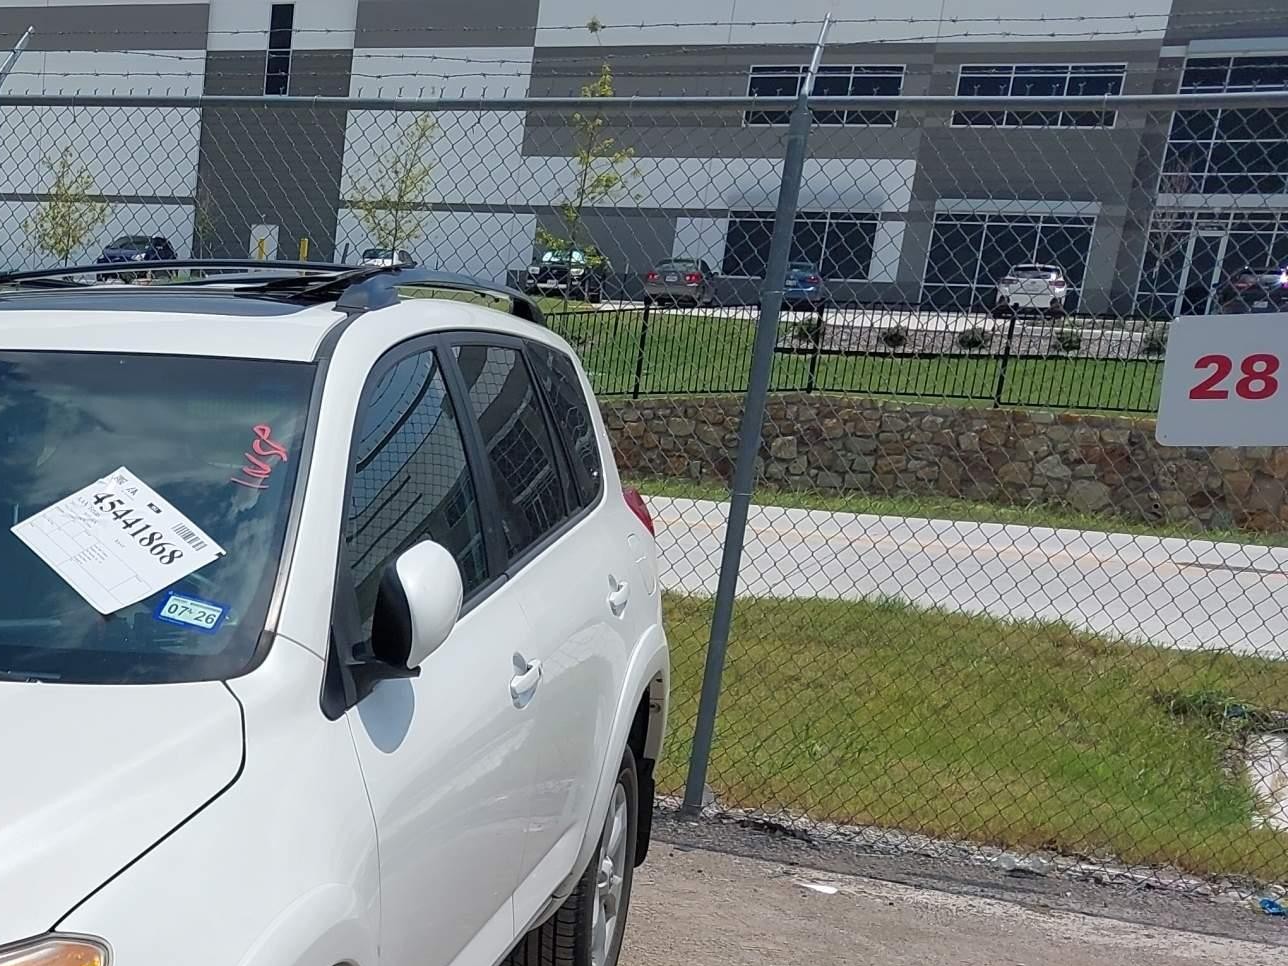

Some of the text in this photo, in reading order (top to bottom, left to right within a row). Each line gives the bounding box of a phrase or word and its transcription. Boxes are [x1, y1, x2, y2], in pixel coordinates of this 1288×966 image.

[1188, 353, 1281, 401] 28
[93, 492, 184, 566] 45441868
[167, 603, 189, 616] 07
[193, 610, 216, 624] 26
